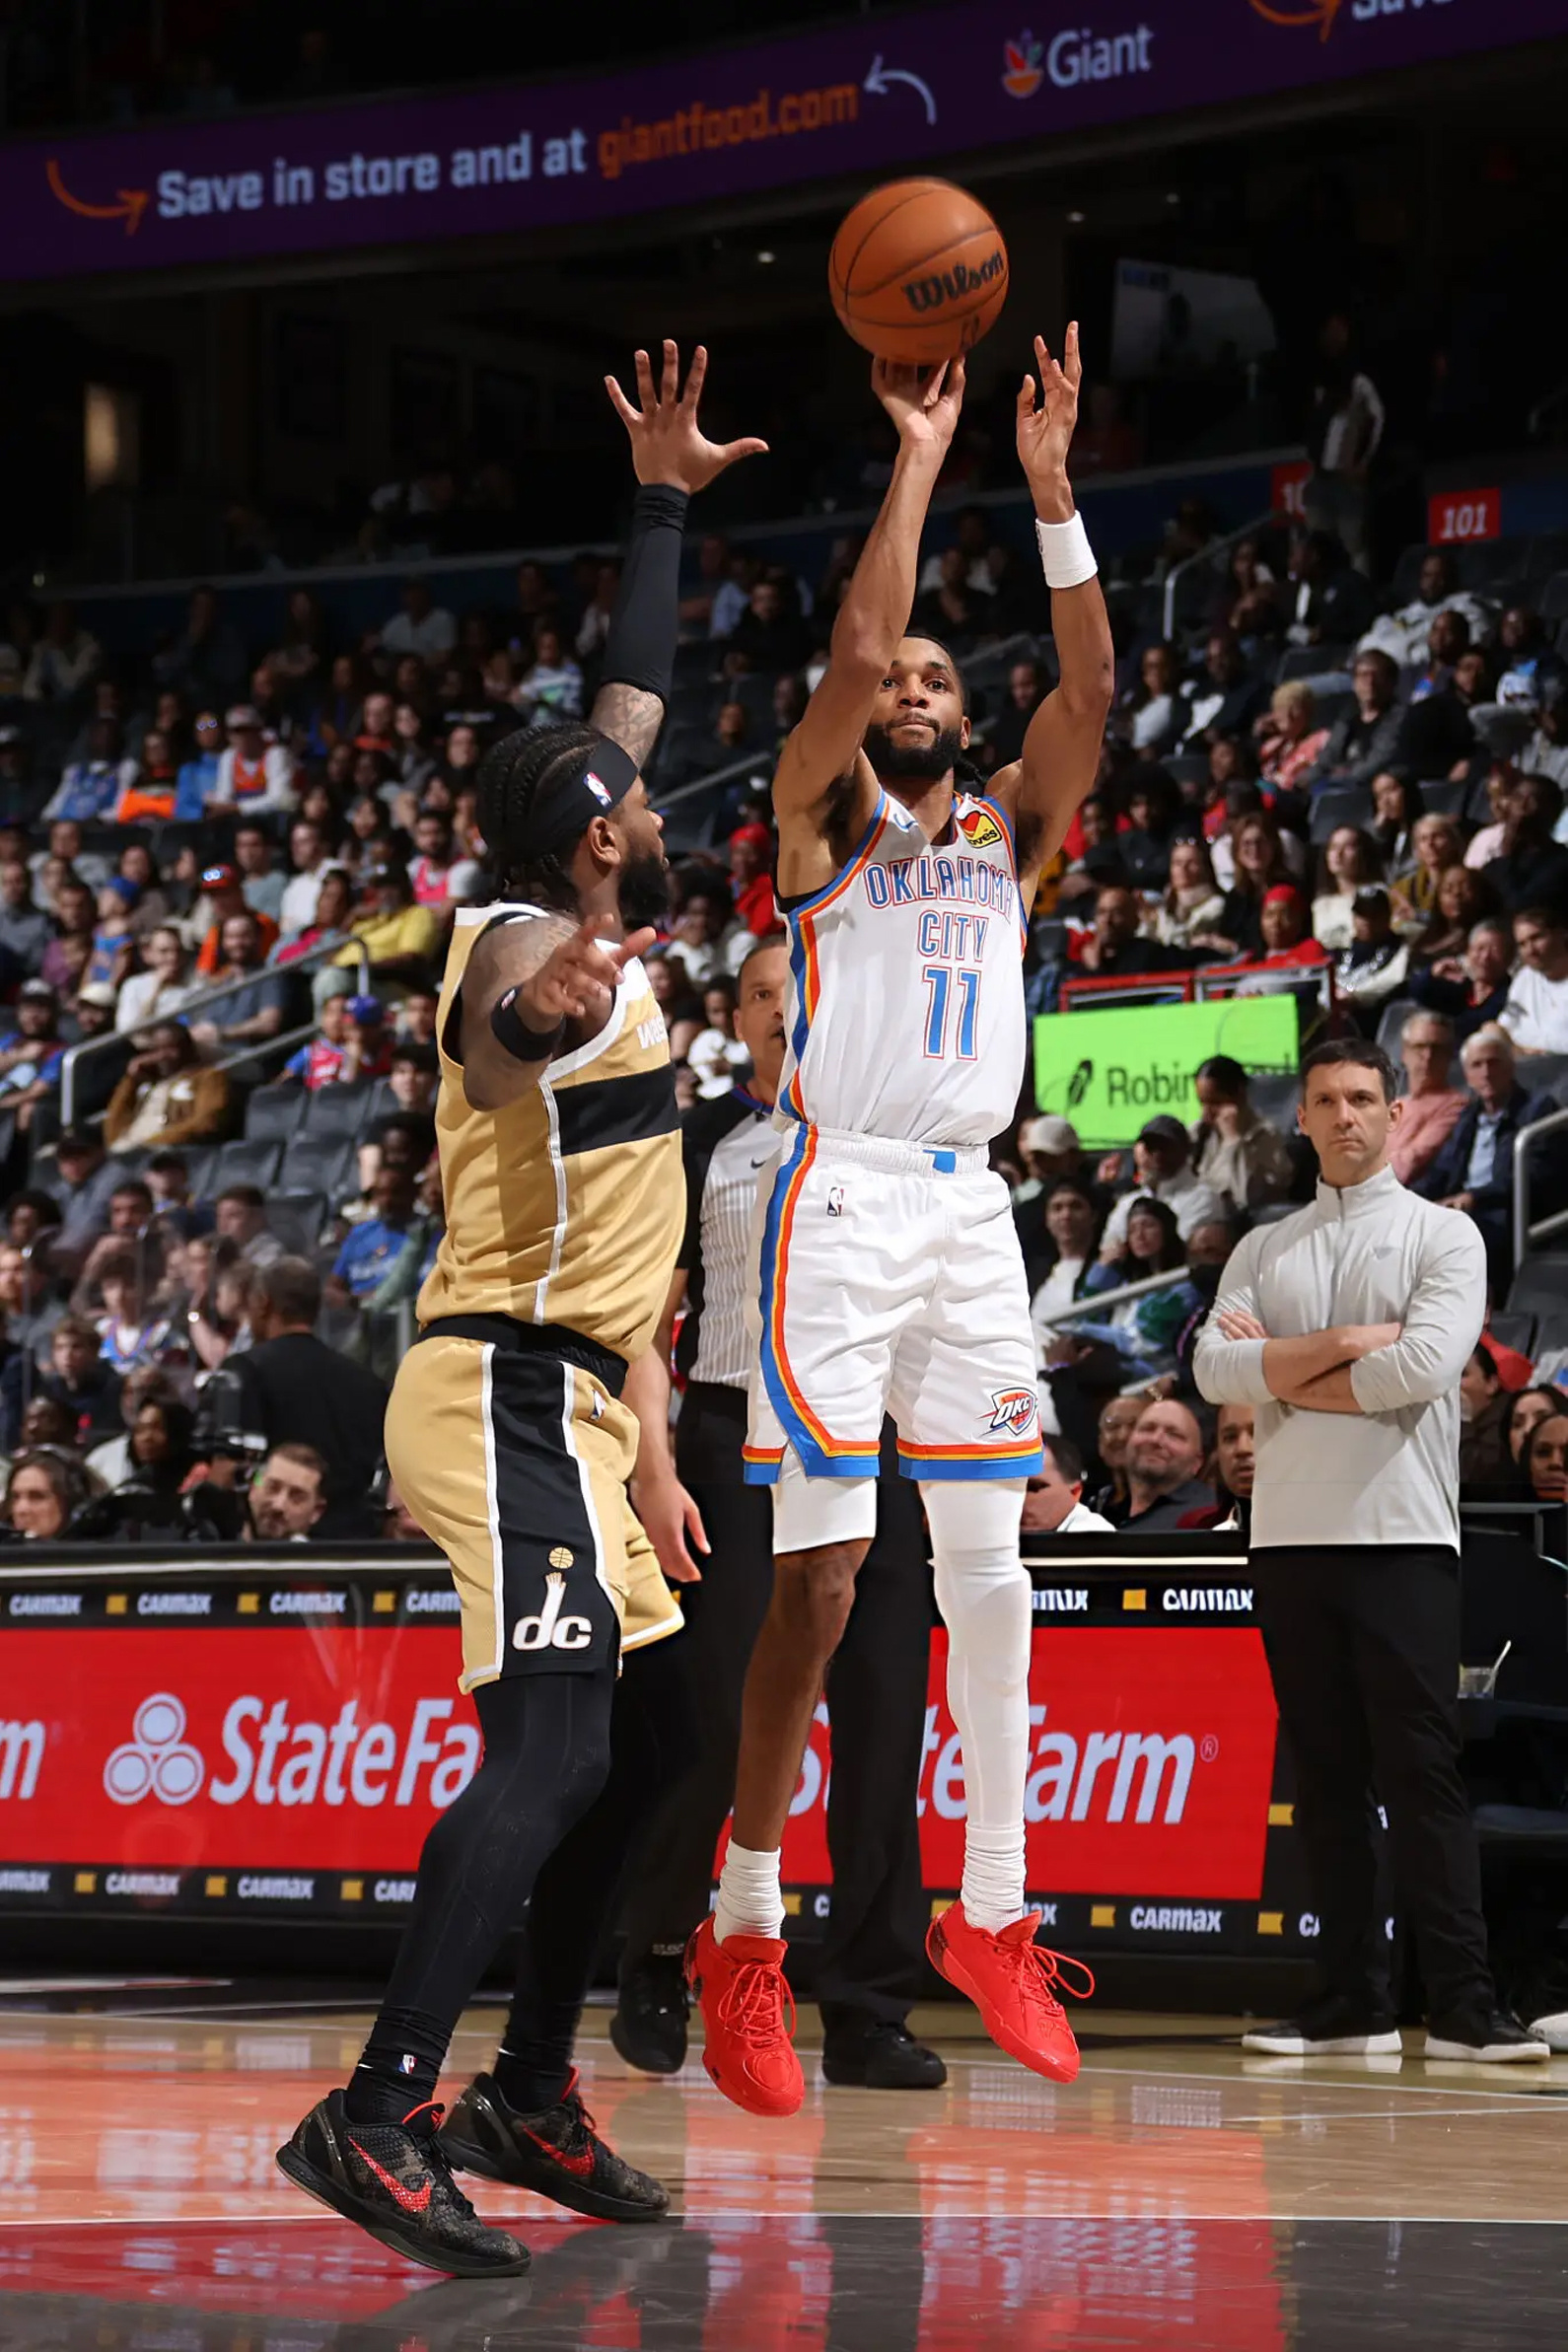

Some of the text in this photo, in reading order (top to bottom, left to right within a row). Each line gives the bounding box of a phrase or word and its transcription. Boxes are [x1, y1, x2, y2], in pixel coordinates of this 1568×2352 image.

[1047, 26, 1153, 88] Giant
[158, 83, 858, 218] Save in store and at giantfood.com
[900, 249, 1004, 313] Wilson
[1440, 503, 1487, 539] 101
[864, 855, 1013, 922] OKLAHOMA
[917, 909, 989, 962] CITY
[922, 964, 981, 1061] 11
[992, 1396, 1030, 1427] OKC
[209, 1694, 481, 1809] State Fa
[1026, 1704, 1195, 1824] arm
